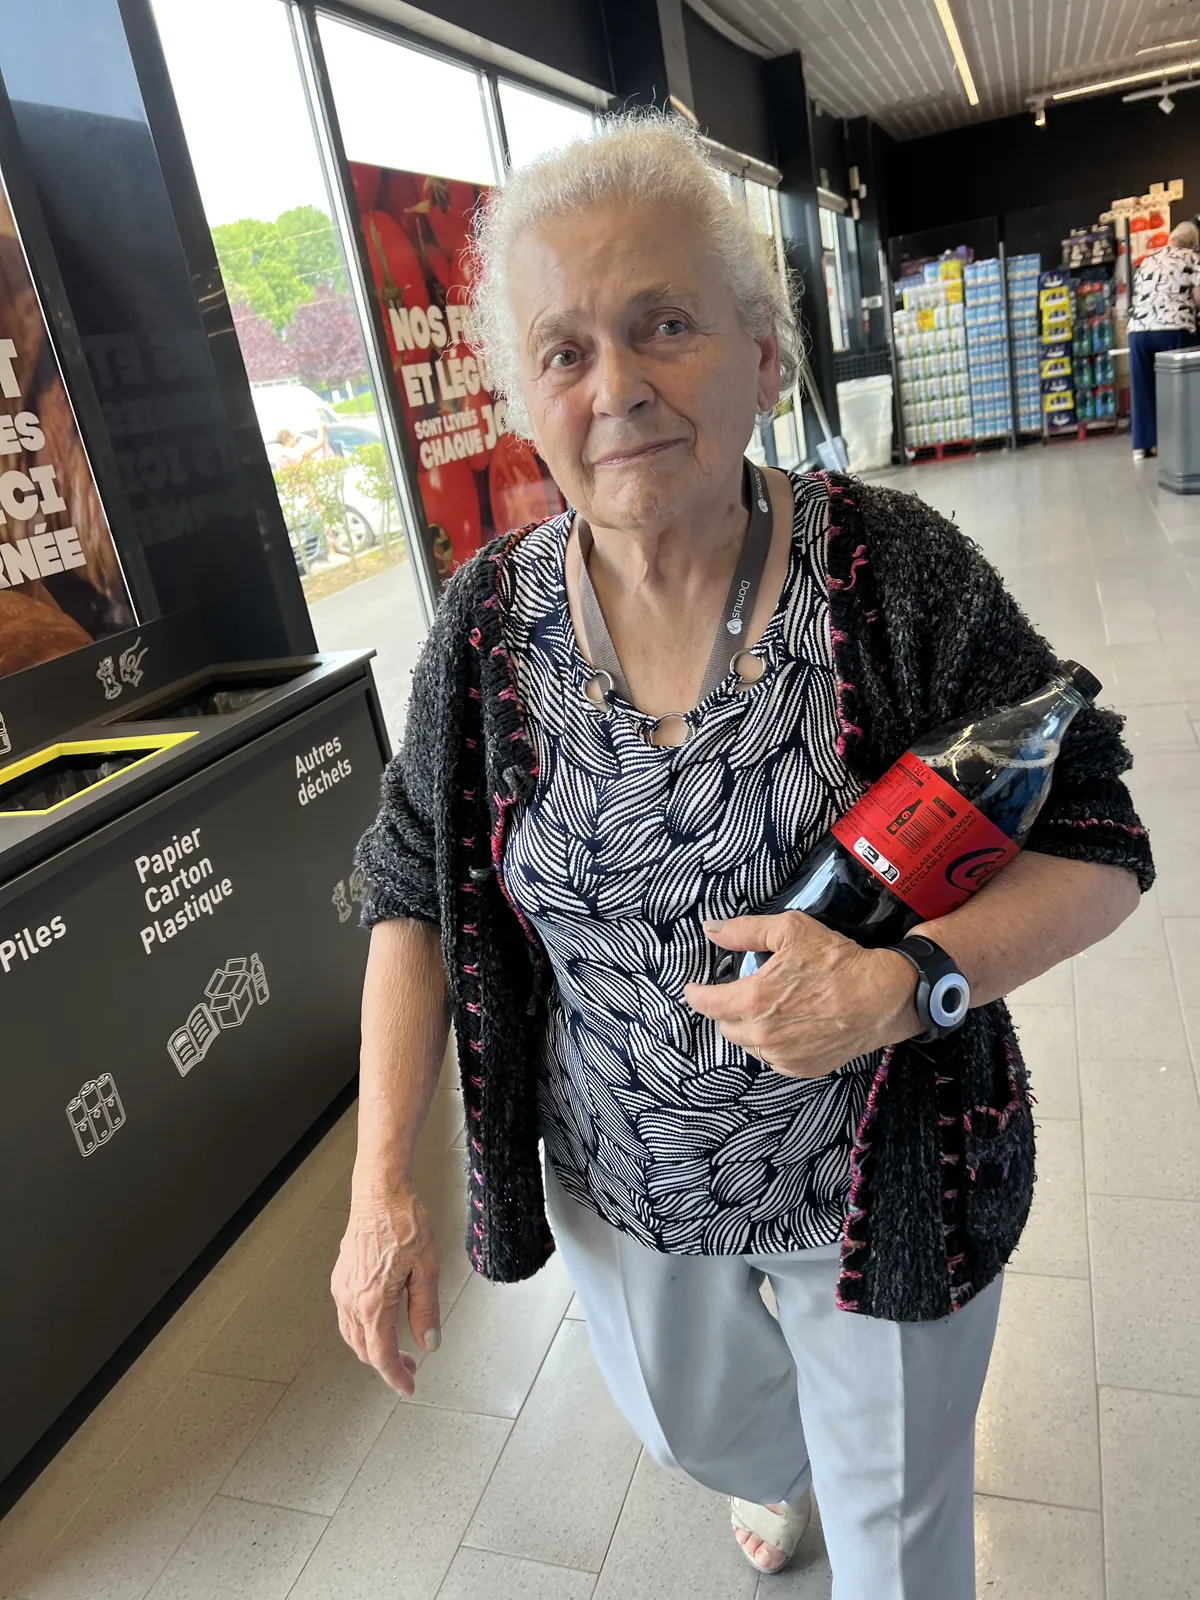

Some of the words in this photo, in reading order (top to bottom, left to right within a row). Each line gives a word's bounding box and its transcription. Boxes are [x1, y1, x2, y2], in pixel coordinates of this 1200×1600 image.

[388, 305, 447, 351] NOS
[0, 339, 21, 398] T
[401, 362, 435, 407] ET
[0, 411, 46, 455] ES
[414, 416, 443, 440] SONT
[442, 406, 478, 432] LIVRÉS
[419, 428, 484, 469] CHAQUE
[481, 402, 508, 450] JO
[0, 464, 67, 524] CI
[732, 580, 750, 618] Domus
[295, 736, 342, 779] Autres
[298, 759, 352, 806] déchets
[901, 810, 911, 820] 6
[134, 827, 201, 884] Papier
[895, 851, 934, 891] EMBALLAGE
[901, 852, 945, 897] RECYCLABLE
[144, 857, 214, 913] Carton
[140, 878, 233, 955] Plastique
[0, 915, 67, 973] Piles
